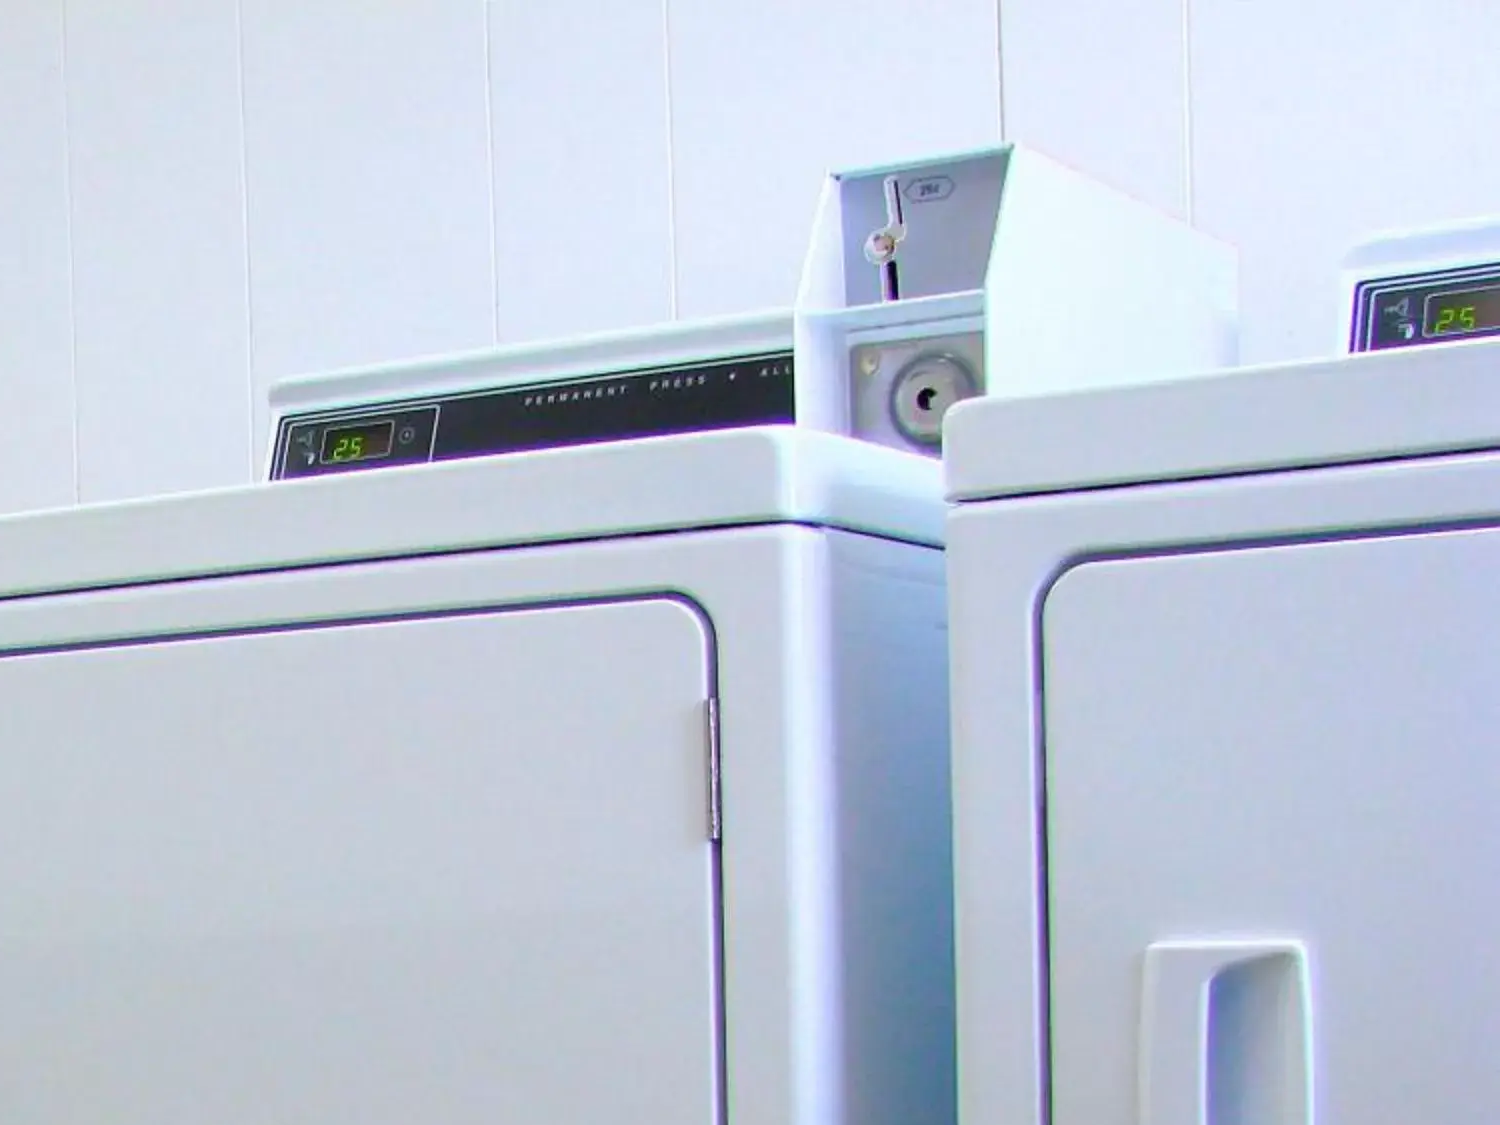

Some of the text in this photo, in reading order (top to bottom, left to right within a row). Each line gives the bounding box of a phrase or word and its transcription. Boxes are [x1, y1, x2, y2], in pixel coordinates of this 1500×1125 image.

[1435, 306, 1476, 333] 25
[524, 384, 629, 407] PERMANENT
[650, 375, 706, 392] PRESS
[333, 436, 364, 461] 25
